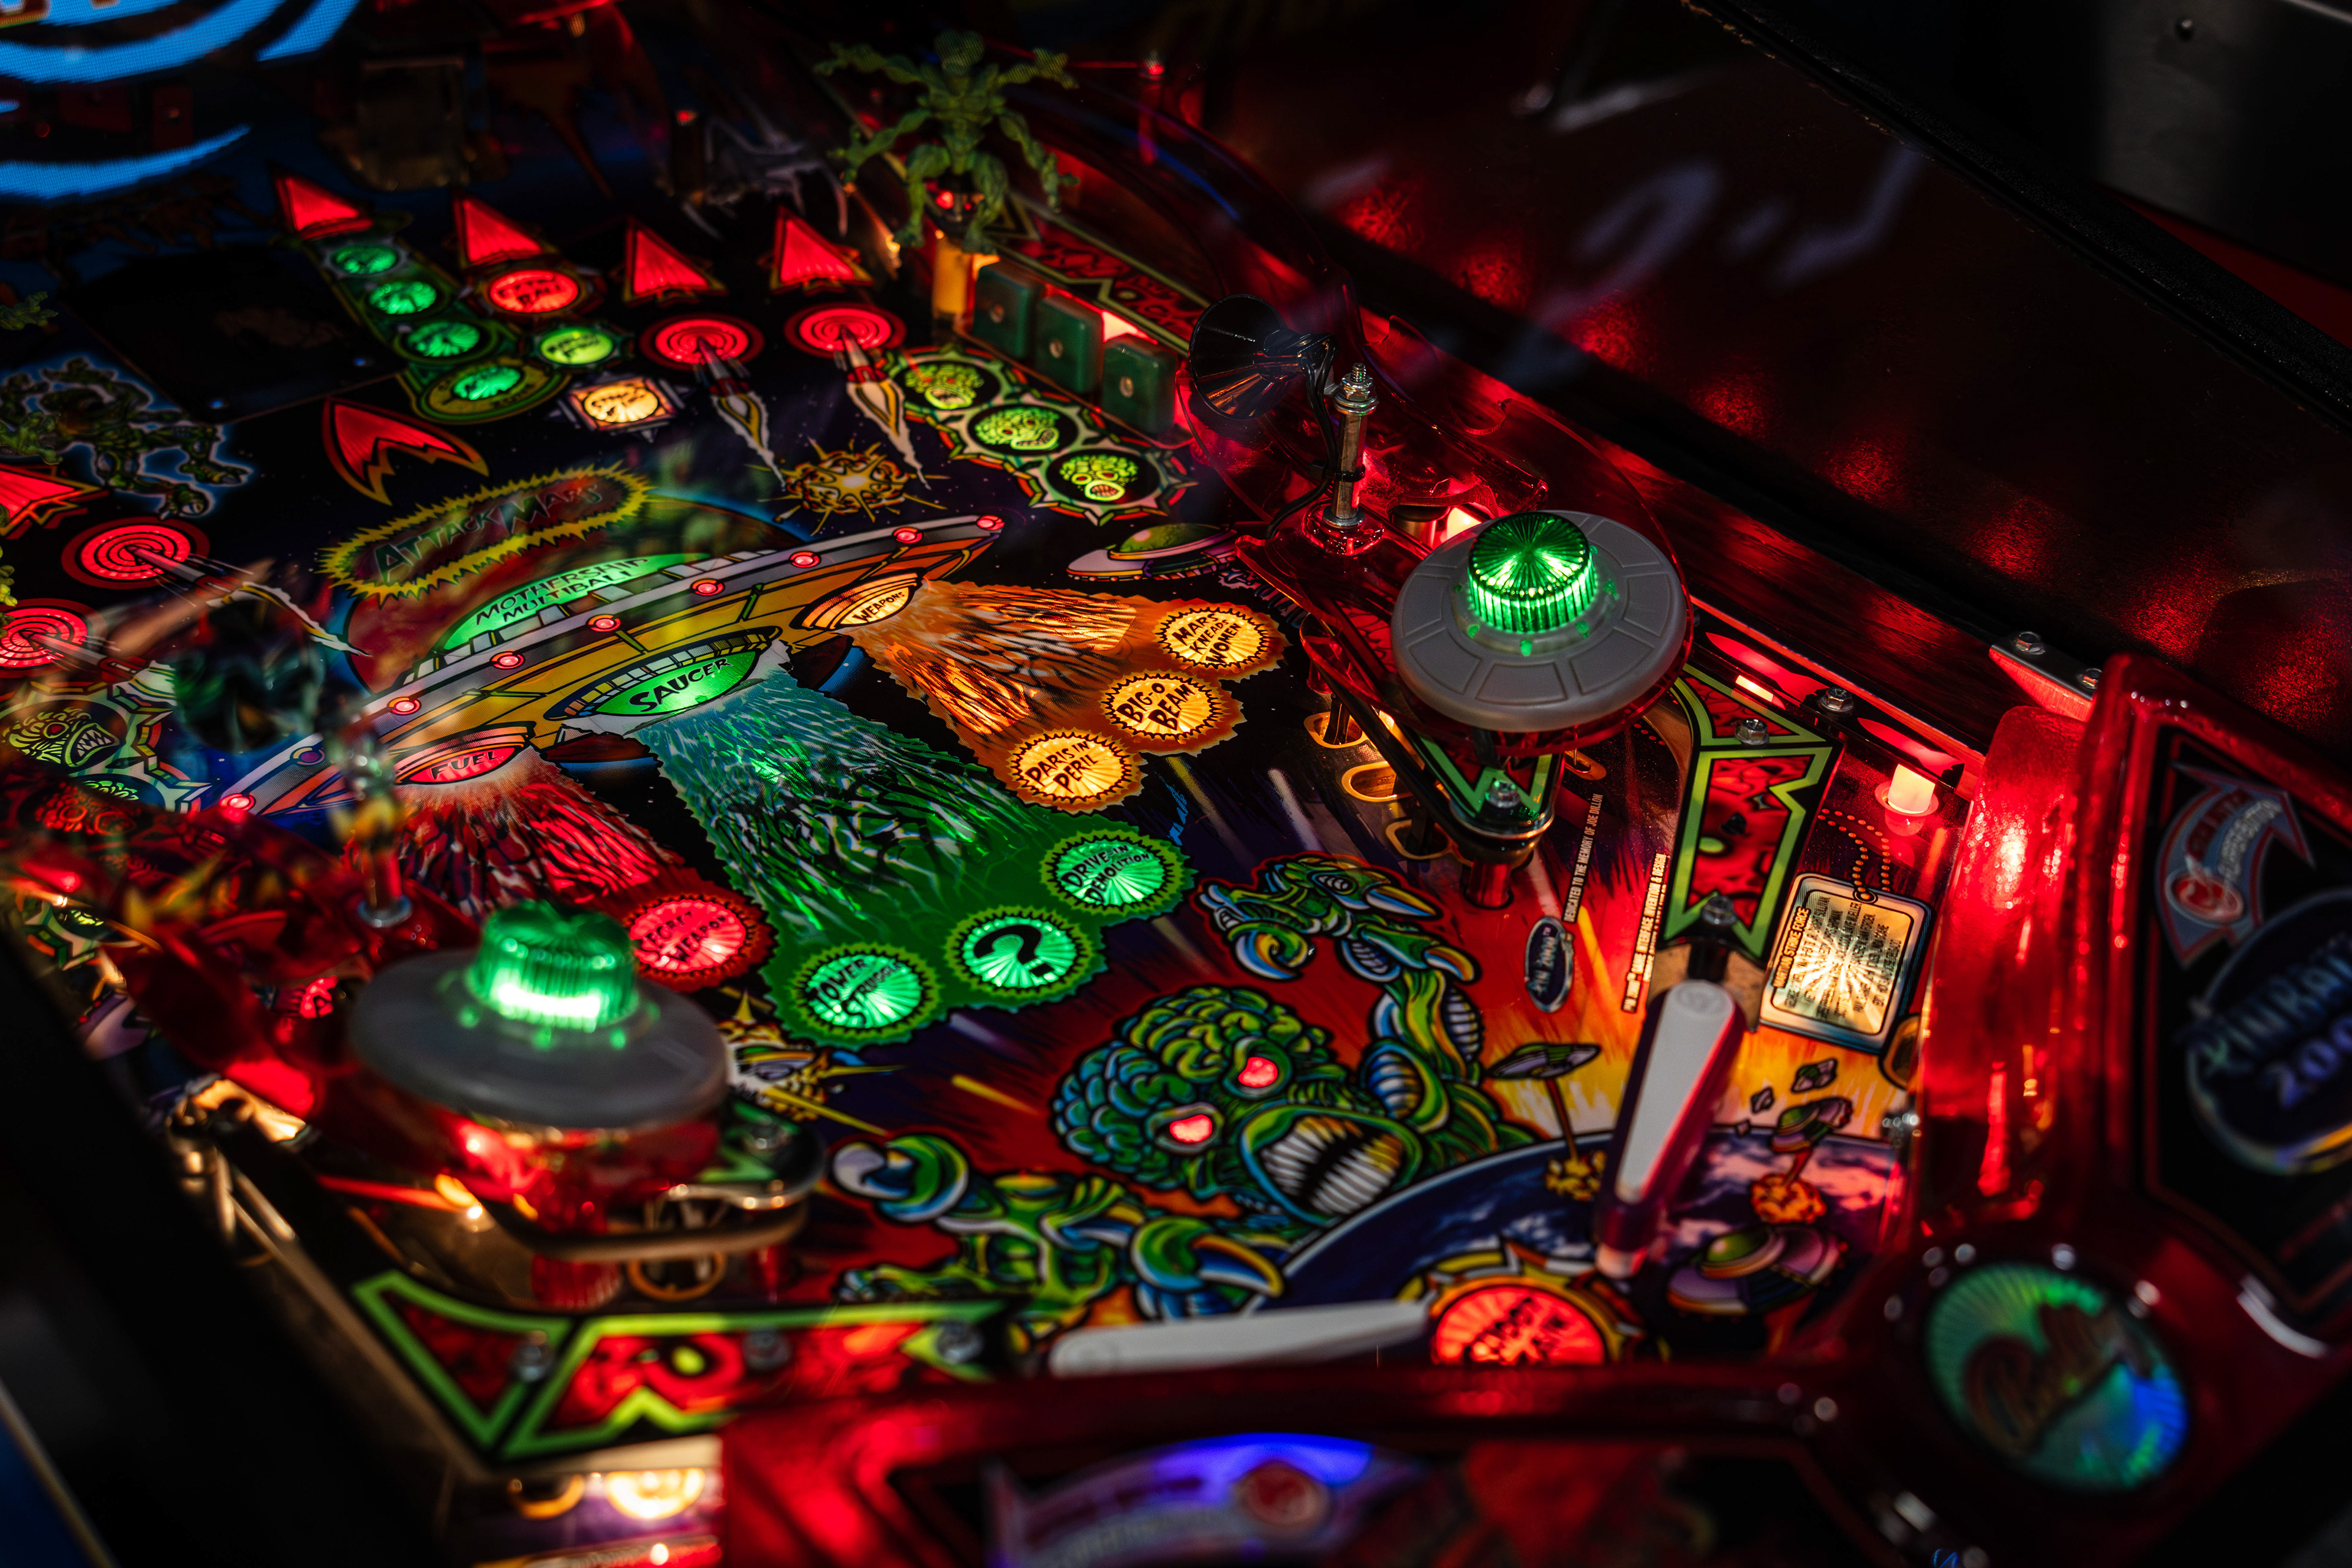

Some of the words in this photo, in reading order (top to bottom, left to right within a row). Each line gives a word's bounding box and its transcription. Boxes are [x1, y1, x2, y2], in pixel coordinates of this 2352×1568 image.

[374, 510, 491, 583] ATTACK
[493, 484, 602, 535] MARS
[476, 558, 649, 625] MOTHERSHIP
[503, 571, 633, 622] MULTIBALL
[852, 592, 905, 622] WEAPONS
[1172, 613, 1219, 646] MARS
[1189, 620, 1229, 655] KNEADS
[1205, 623, 1242, 664] WOMEN
[629, 658, 734, 713] SAUCER
[1116, 683, 1166, 724] BIG-O
[1148, 684, 1196, 731] BEAM
[430, 750, 497, 780] FUEL
[1025, 748, 1073, 787] PARIS
[1071, 741, 1090, 754] IN
[1052, 754, 1098, 794] PERIL
[1586, 814, 1599, 827] JOE
[1589, 793, 1603, 815] DILLON
[1577, 835, 1594, 864] MEMORY
[1584, 826, 1596, 836] OF
[1060, 845, 1129, 888] DRIVE-IN
[1084, 853, 1150, 903] DEMOLITION
[1572, 876, 1585, 886] TO
[1574, 864, 1588, 876] THE
[1651, 853, 1667, 876] DESIGN
[1643, 882, 1661, 918] INVENTION
[1792, 907, 1810, 932] FORCE
[634, 911, 692, 960] SECRET
[667, 916, 726, 963] WEAPON
[974, 925, 1055, 977] ?
[1635, 916, 1654, 954] INTERFACE
[1784, 930, 1804, 957] STRIKE
[805, 959, 866, 1015] TOWER
[1773, 955, 1793, 988] MARTIAN
[841, 962, 904, 1026] STRUGGLE
